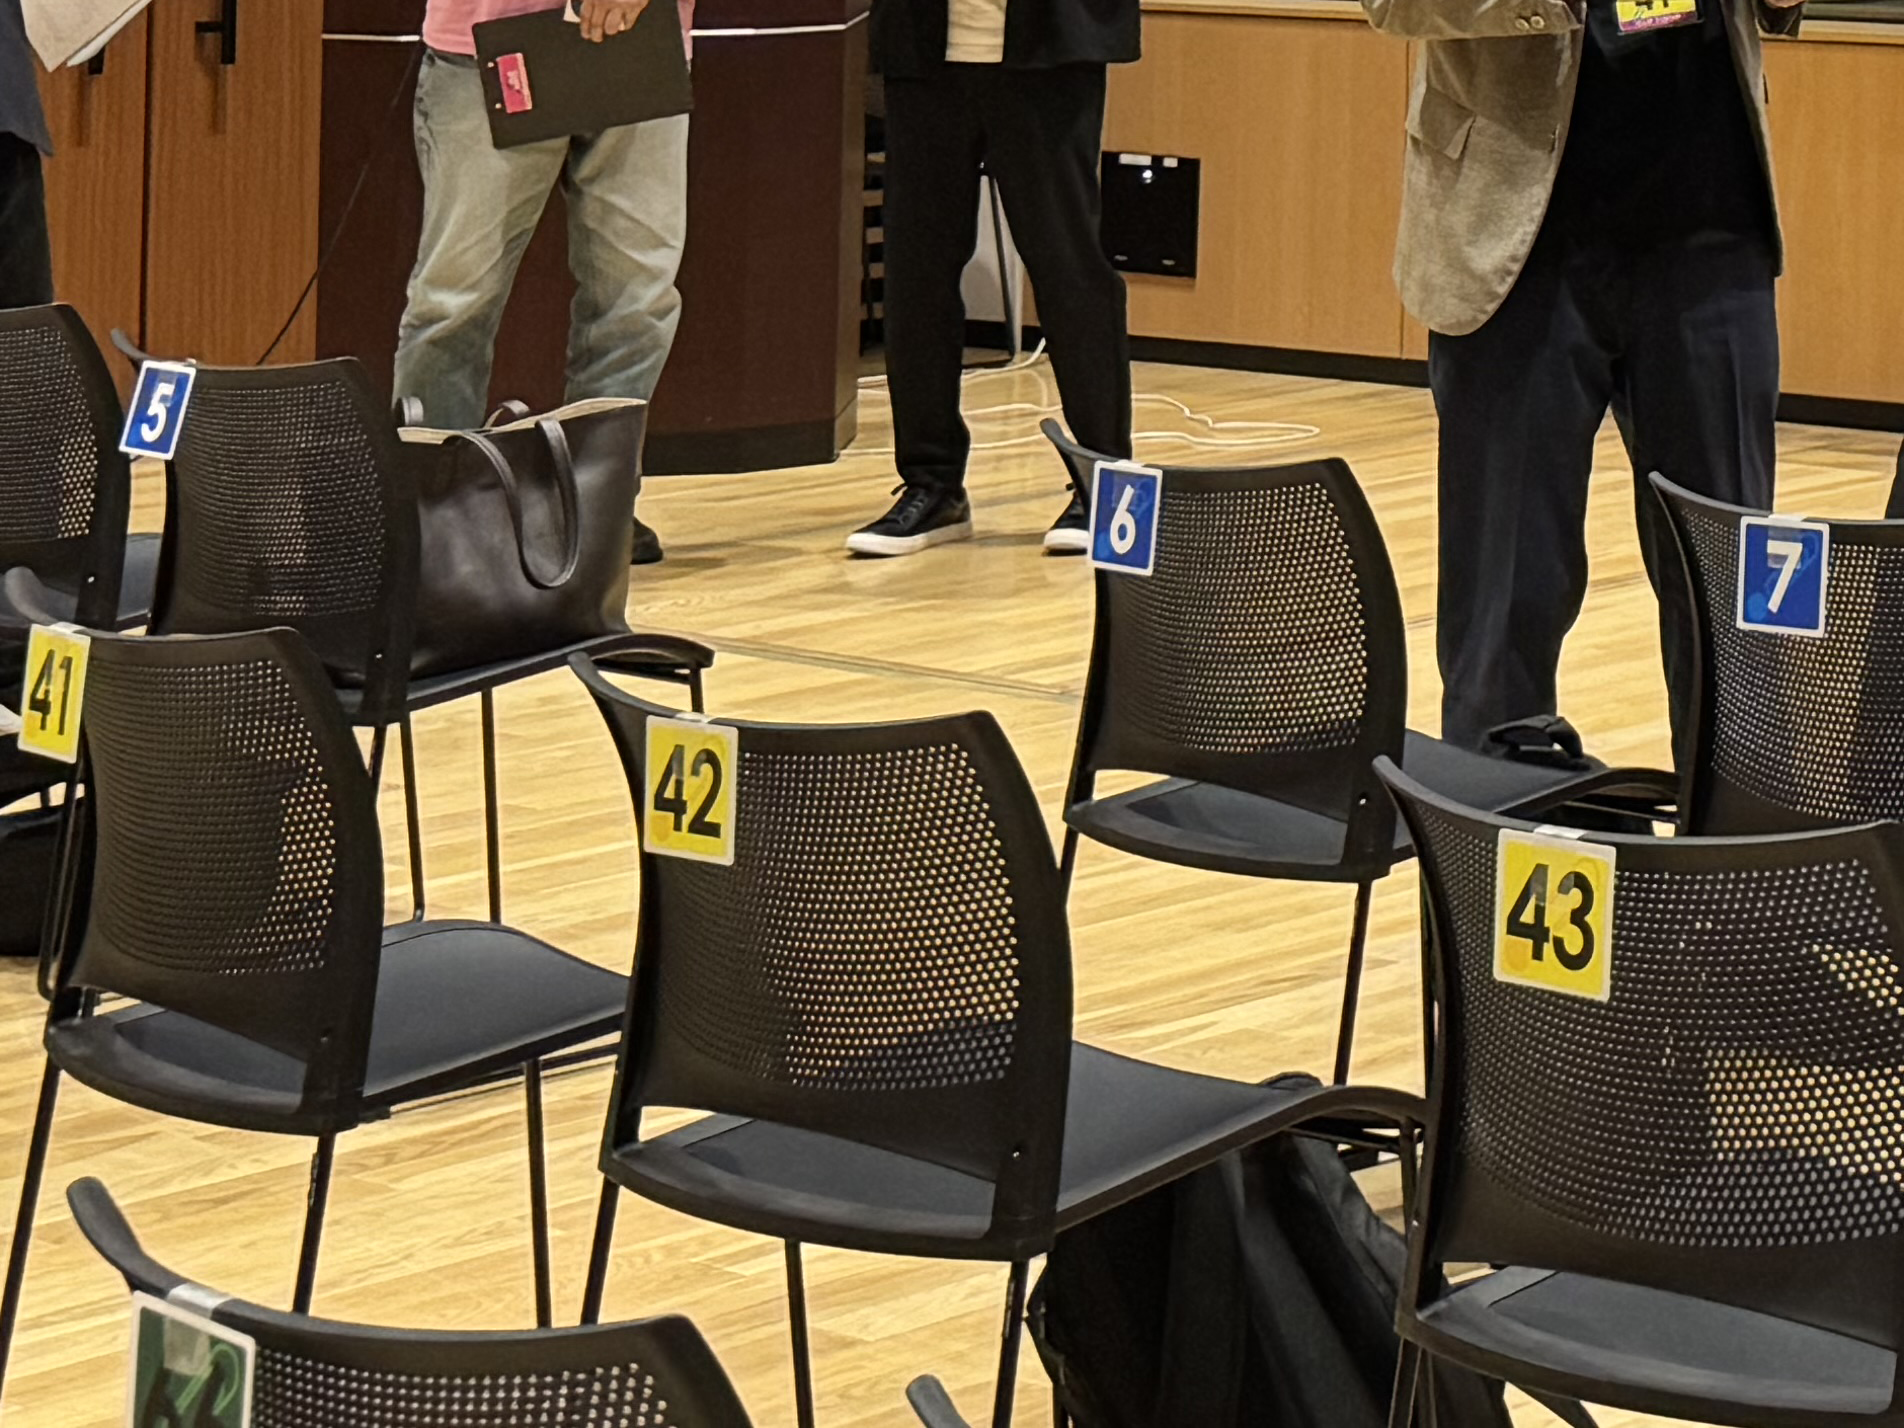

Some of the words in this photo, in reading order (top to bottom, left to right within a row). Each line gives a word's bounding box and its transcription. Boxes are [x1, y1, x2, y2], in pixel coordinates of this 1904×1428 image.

[141, 382, 175, 443] 5
[1110, 484, 1136, 554] 6
[1767, 539, 1803, 613] 7
[28, 649, 73, 735] 41
[654, 744, 722, 838] 42
[1506, 863, 1595, 971] 43
